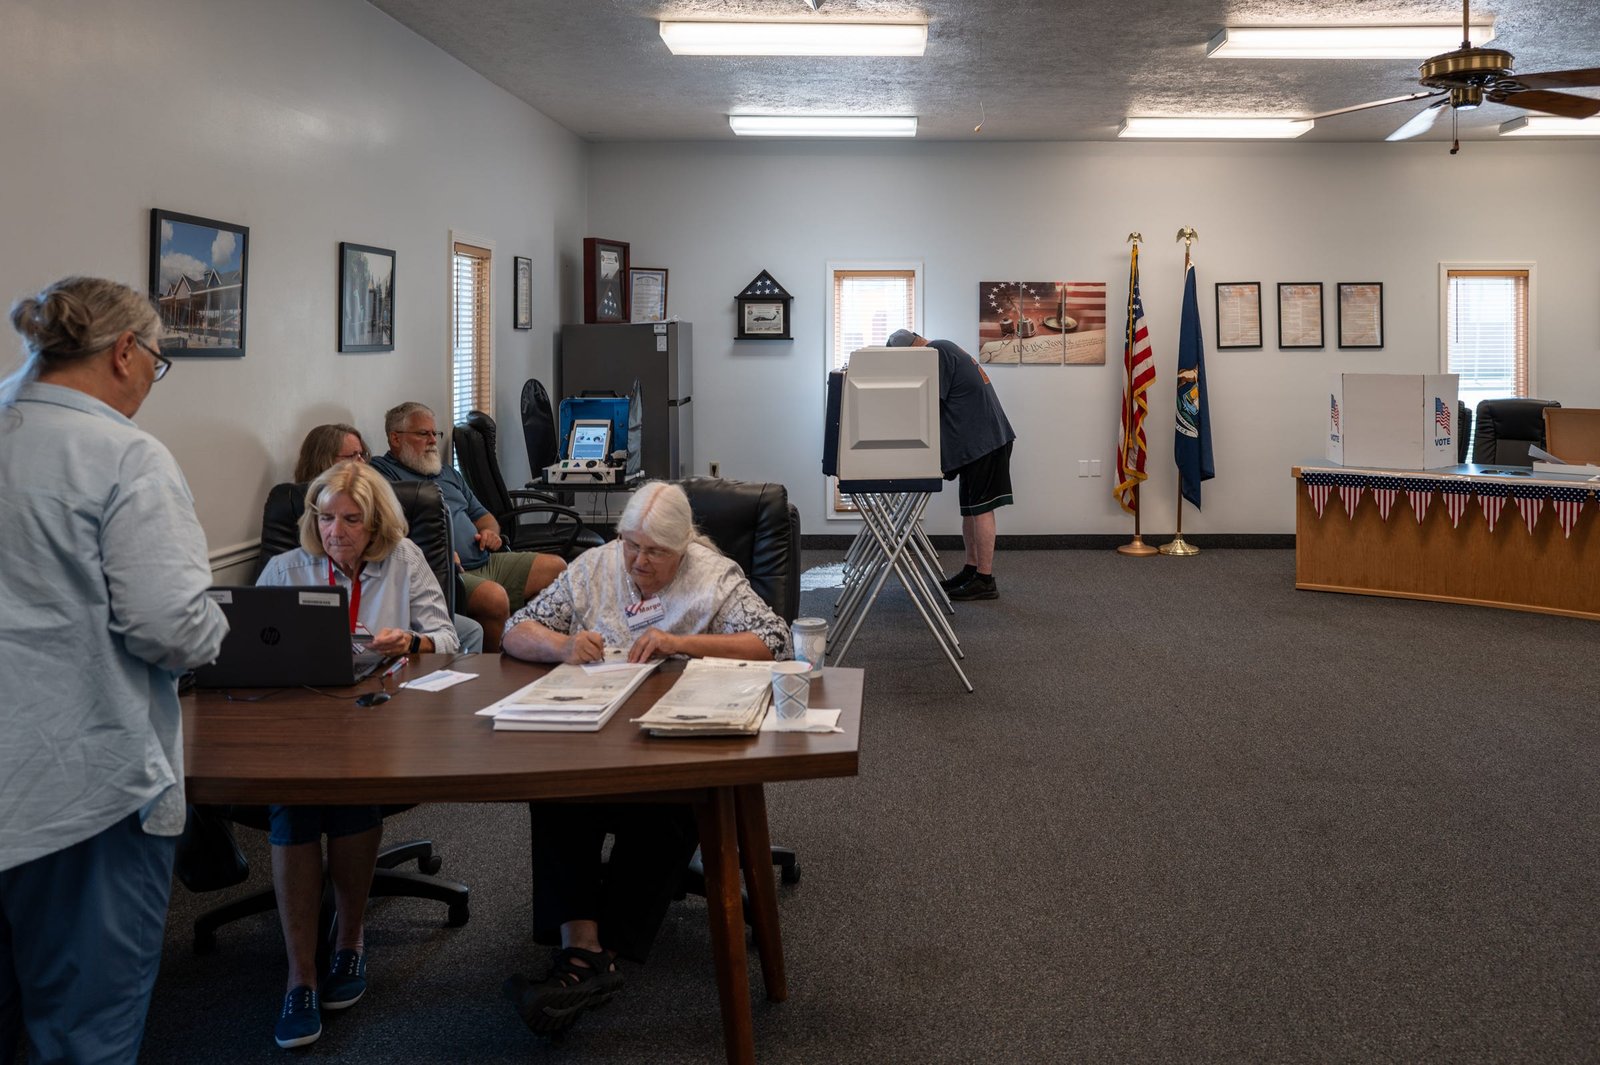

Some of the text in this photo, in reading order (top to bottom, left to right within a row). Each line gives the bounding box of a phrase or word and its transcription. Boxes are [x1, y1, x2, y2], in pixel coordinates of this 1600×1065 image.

[1013, 343, 1030, 354] We
[1030, 341, 1043, 353] the
[1044, 338, 1072, 351] Peope
[1330, 434, 1340, 443] VOTE
[1434, 437, 1451, 446] VOTE
[261, 626, 279, 645] hp
